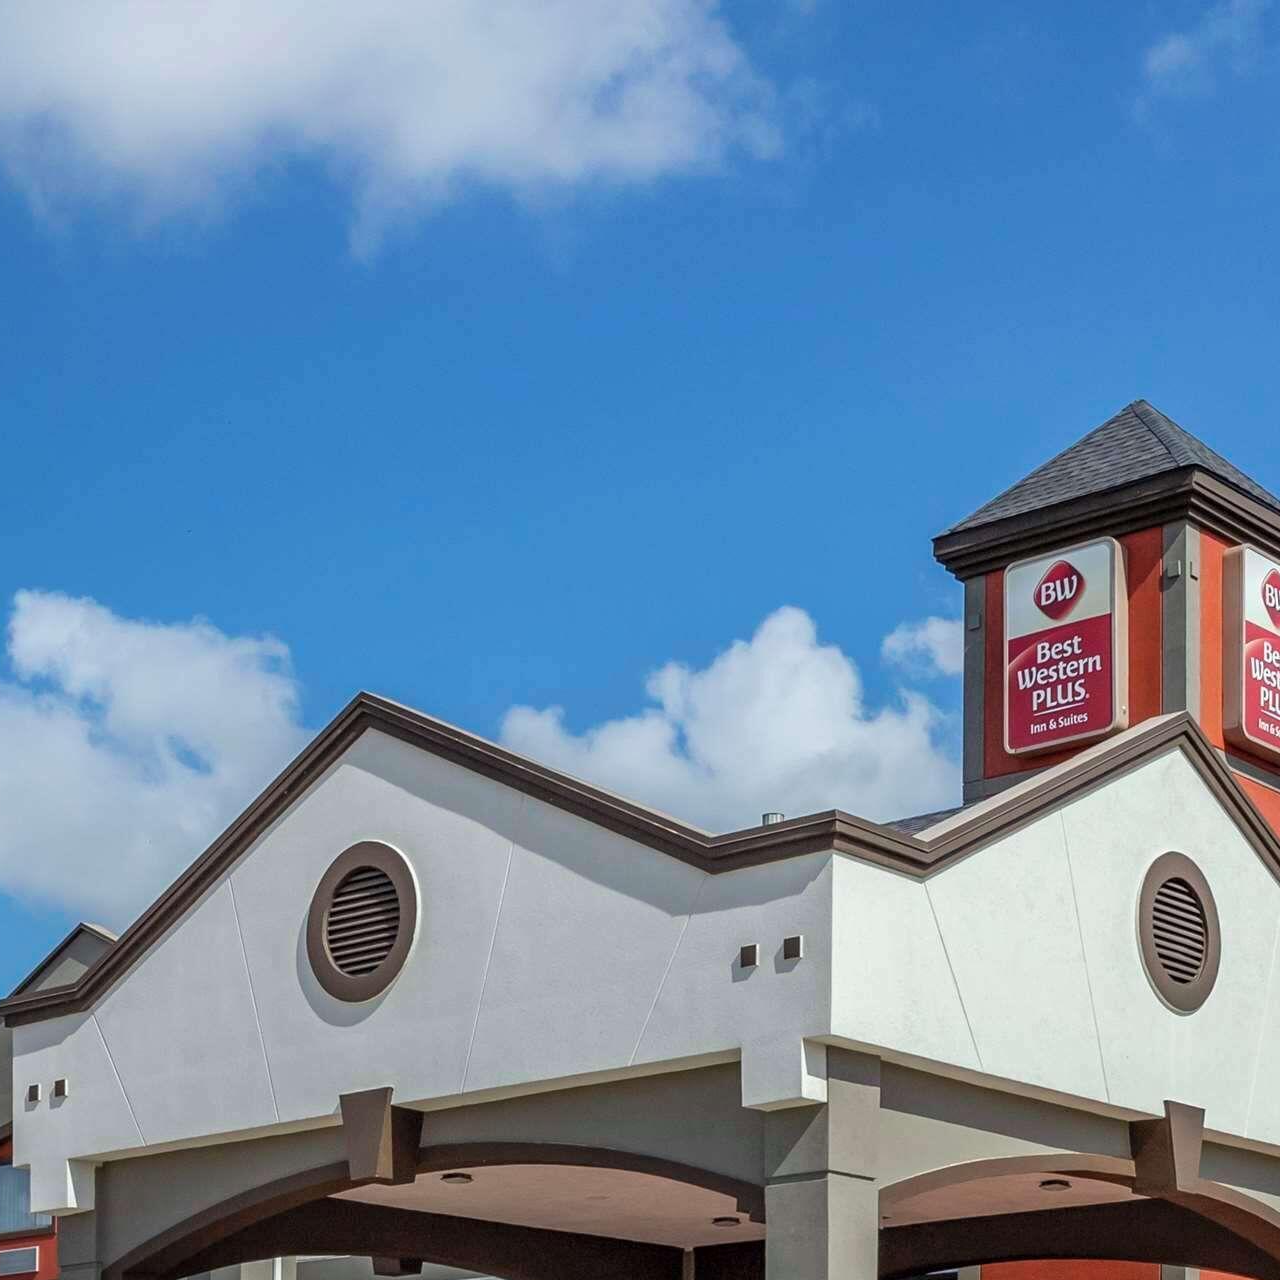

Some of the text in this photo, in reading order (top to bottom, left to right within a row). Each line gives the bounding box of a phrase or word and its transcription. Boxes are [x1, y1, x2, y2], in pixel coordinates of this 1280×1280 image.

[1040, 575, 1078, 606] BW
[1036, 635, 1082, 664] Best
[1017, 654, 1102, 690] Western
[1032, 679, 1087, 711] PLUS
[1030, 712, 1088, 735] Inn & Suites
[1258, 718, 1269, 732] Inn
